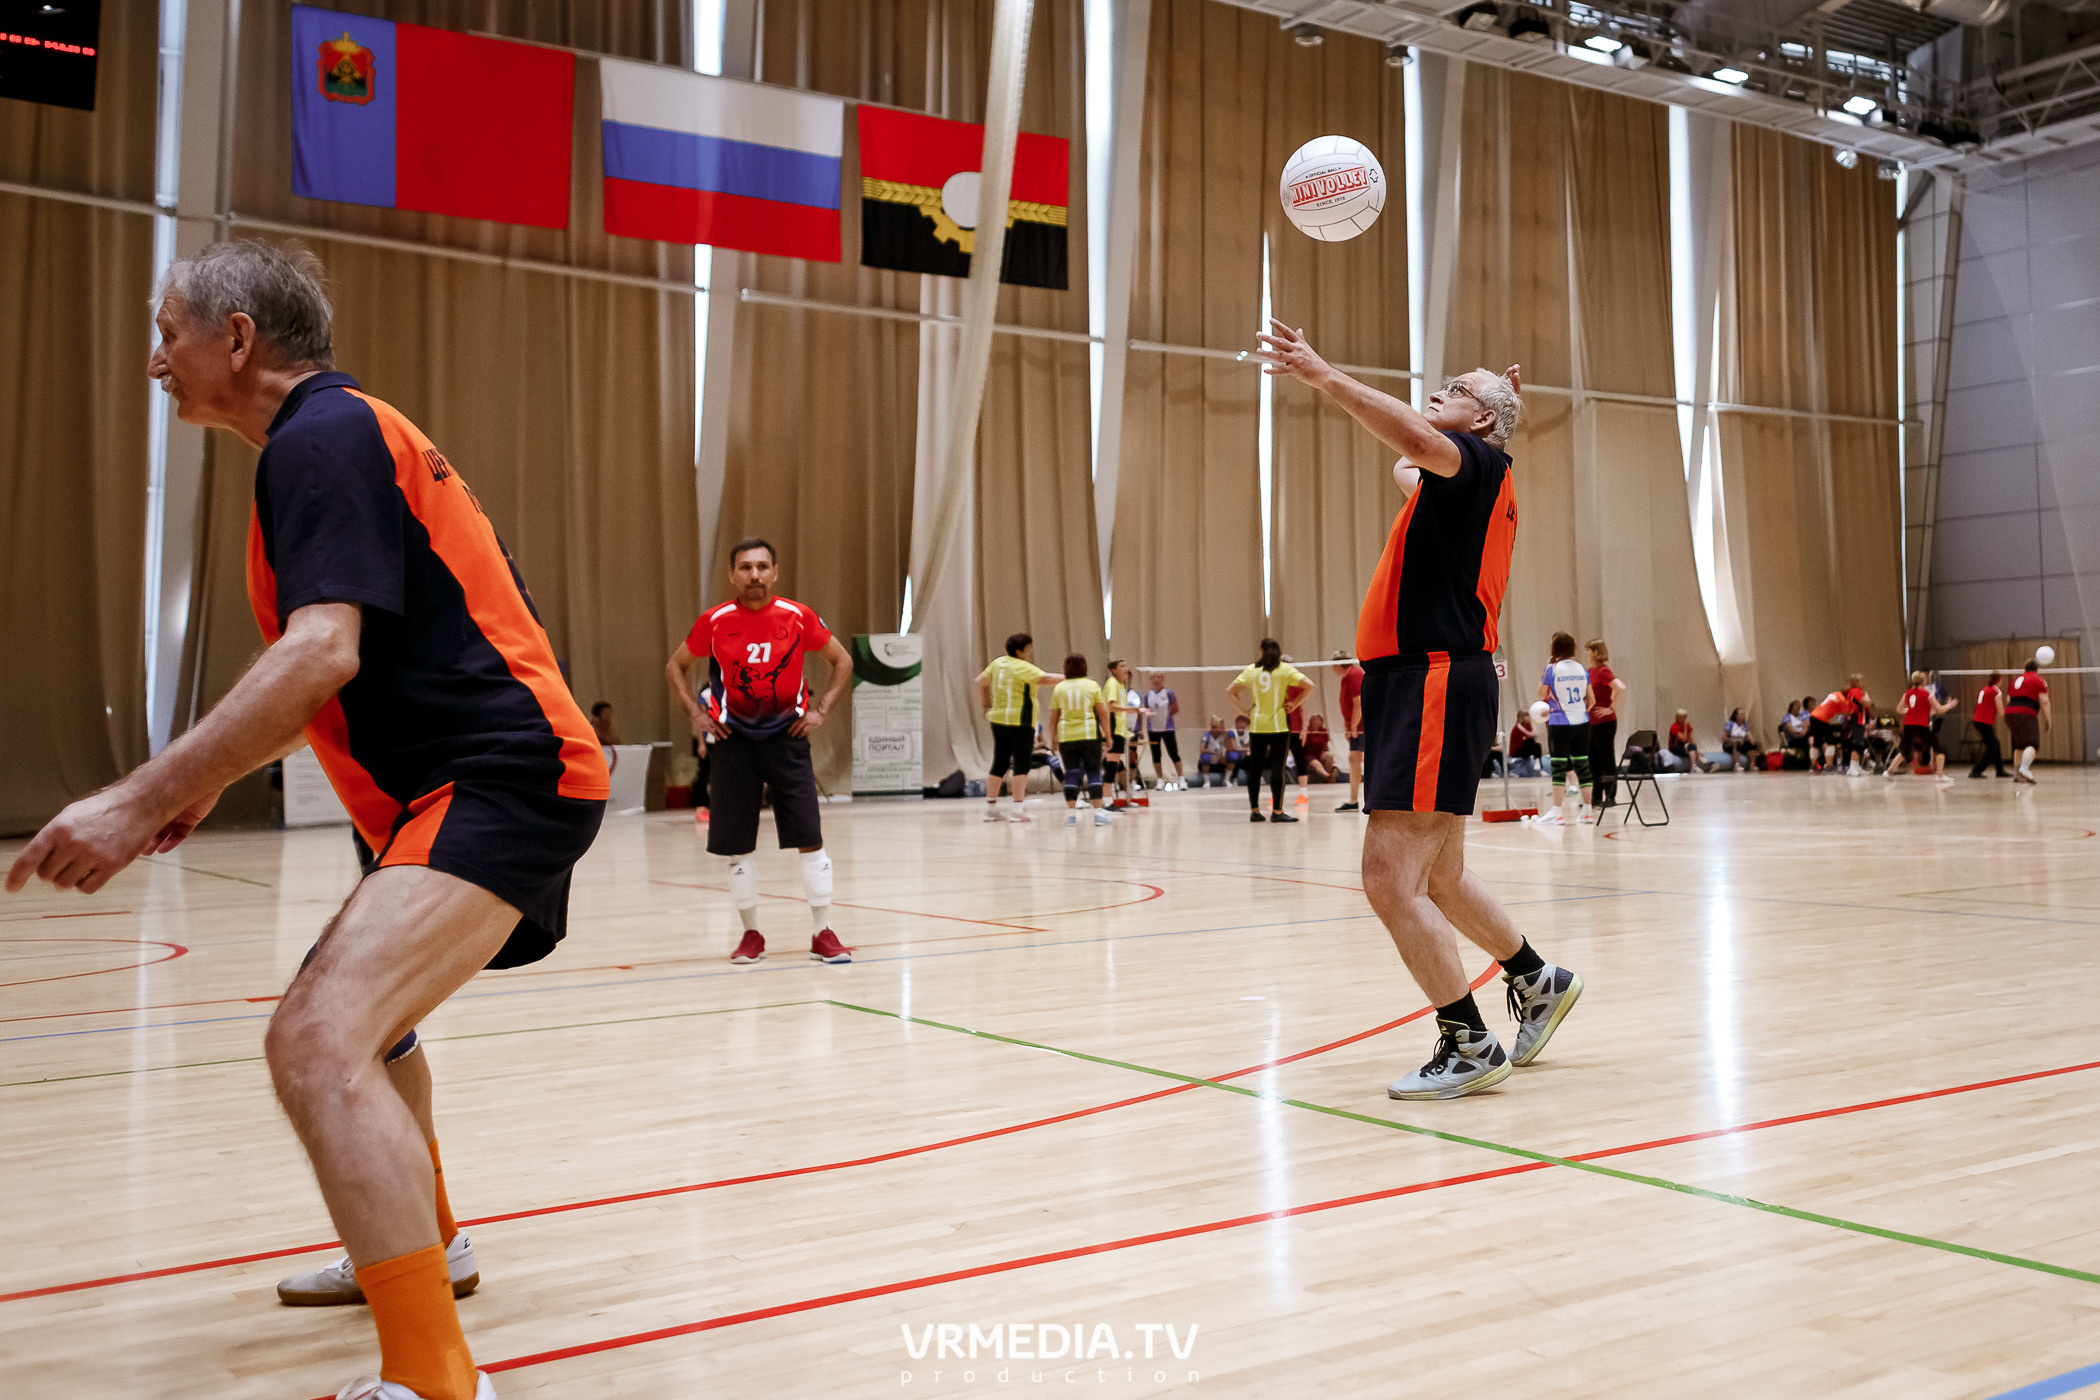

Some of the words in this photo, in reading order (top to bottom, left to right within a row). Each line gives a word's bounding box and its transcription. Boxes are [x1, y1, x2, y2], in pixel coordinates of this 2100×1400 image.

[1308, 170, 1327, 178] OFFICIAL
[1316, 200, 1333, 208] SINCE
[746, 642, 772, 664] 27
[1495, 664, 1506, 678] 3
[1258, 672, 1272, 693] 9
[1066, 688, 1081, 711] 11
[1566, 687, 1581, 705] 13
[868, 743, 904, 752] ПОРТАЛ
